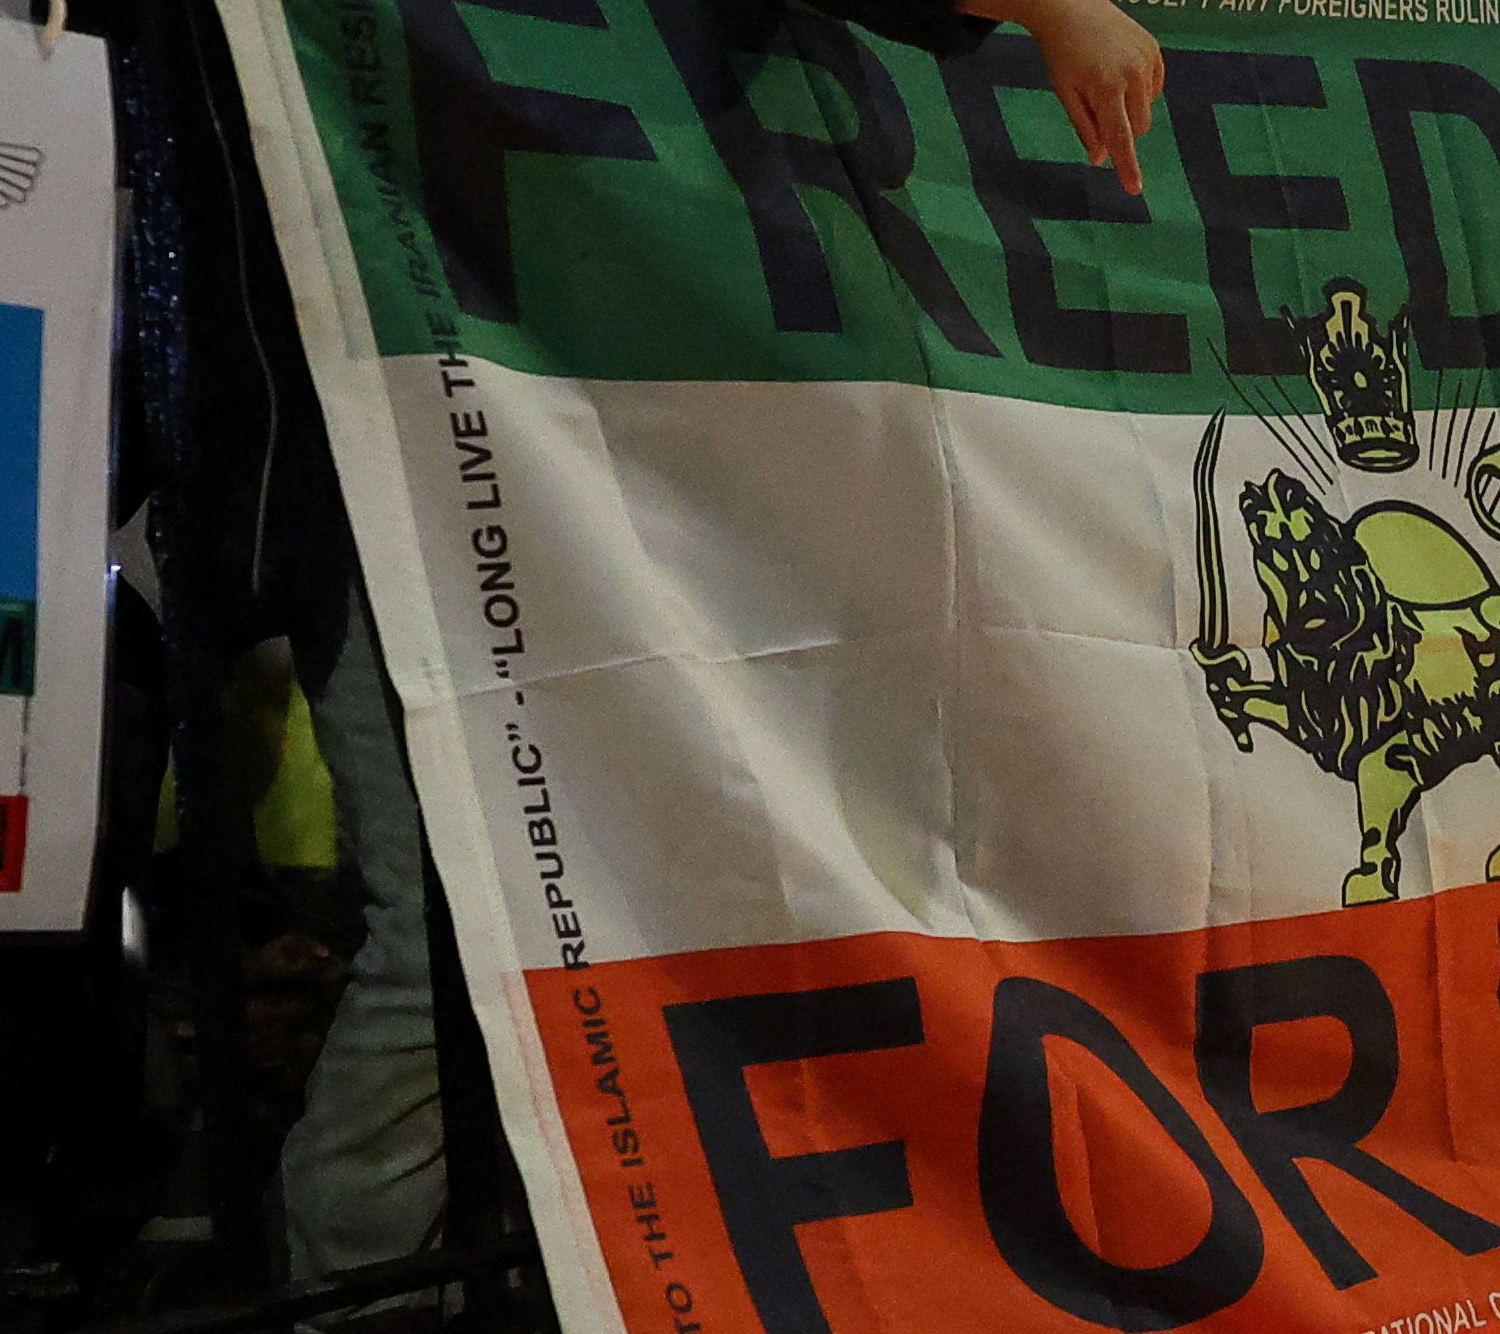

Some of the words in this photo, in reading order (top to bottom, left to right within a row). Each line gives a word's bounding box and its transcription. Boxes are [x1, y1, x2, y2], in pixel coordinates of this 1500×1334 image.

[359, 121, 443, 302] IRANIAN
[427, 310, 476, 399] THE
[449, 409, 500, 512] LIVE
[573, 986, 642, 1169] ISLAMIC
[630, 1179, 677, 1268] THE
